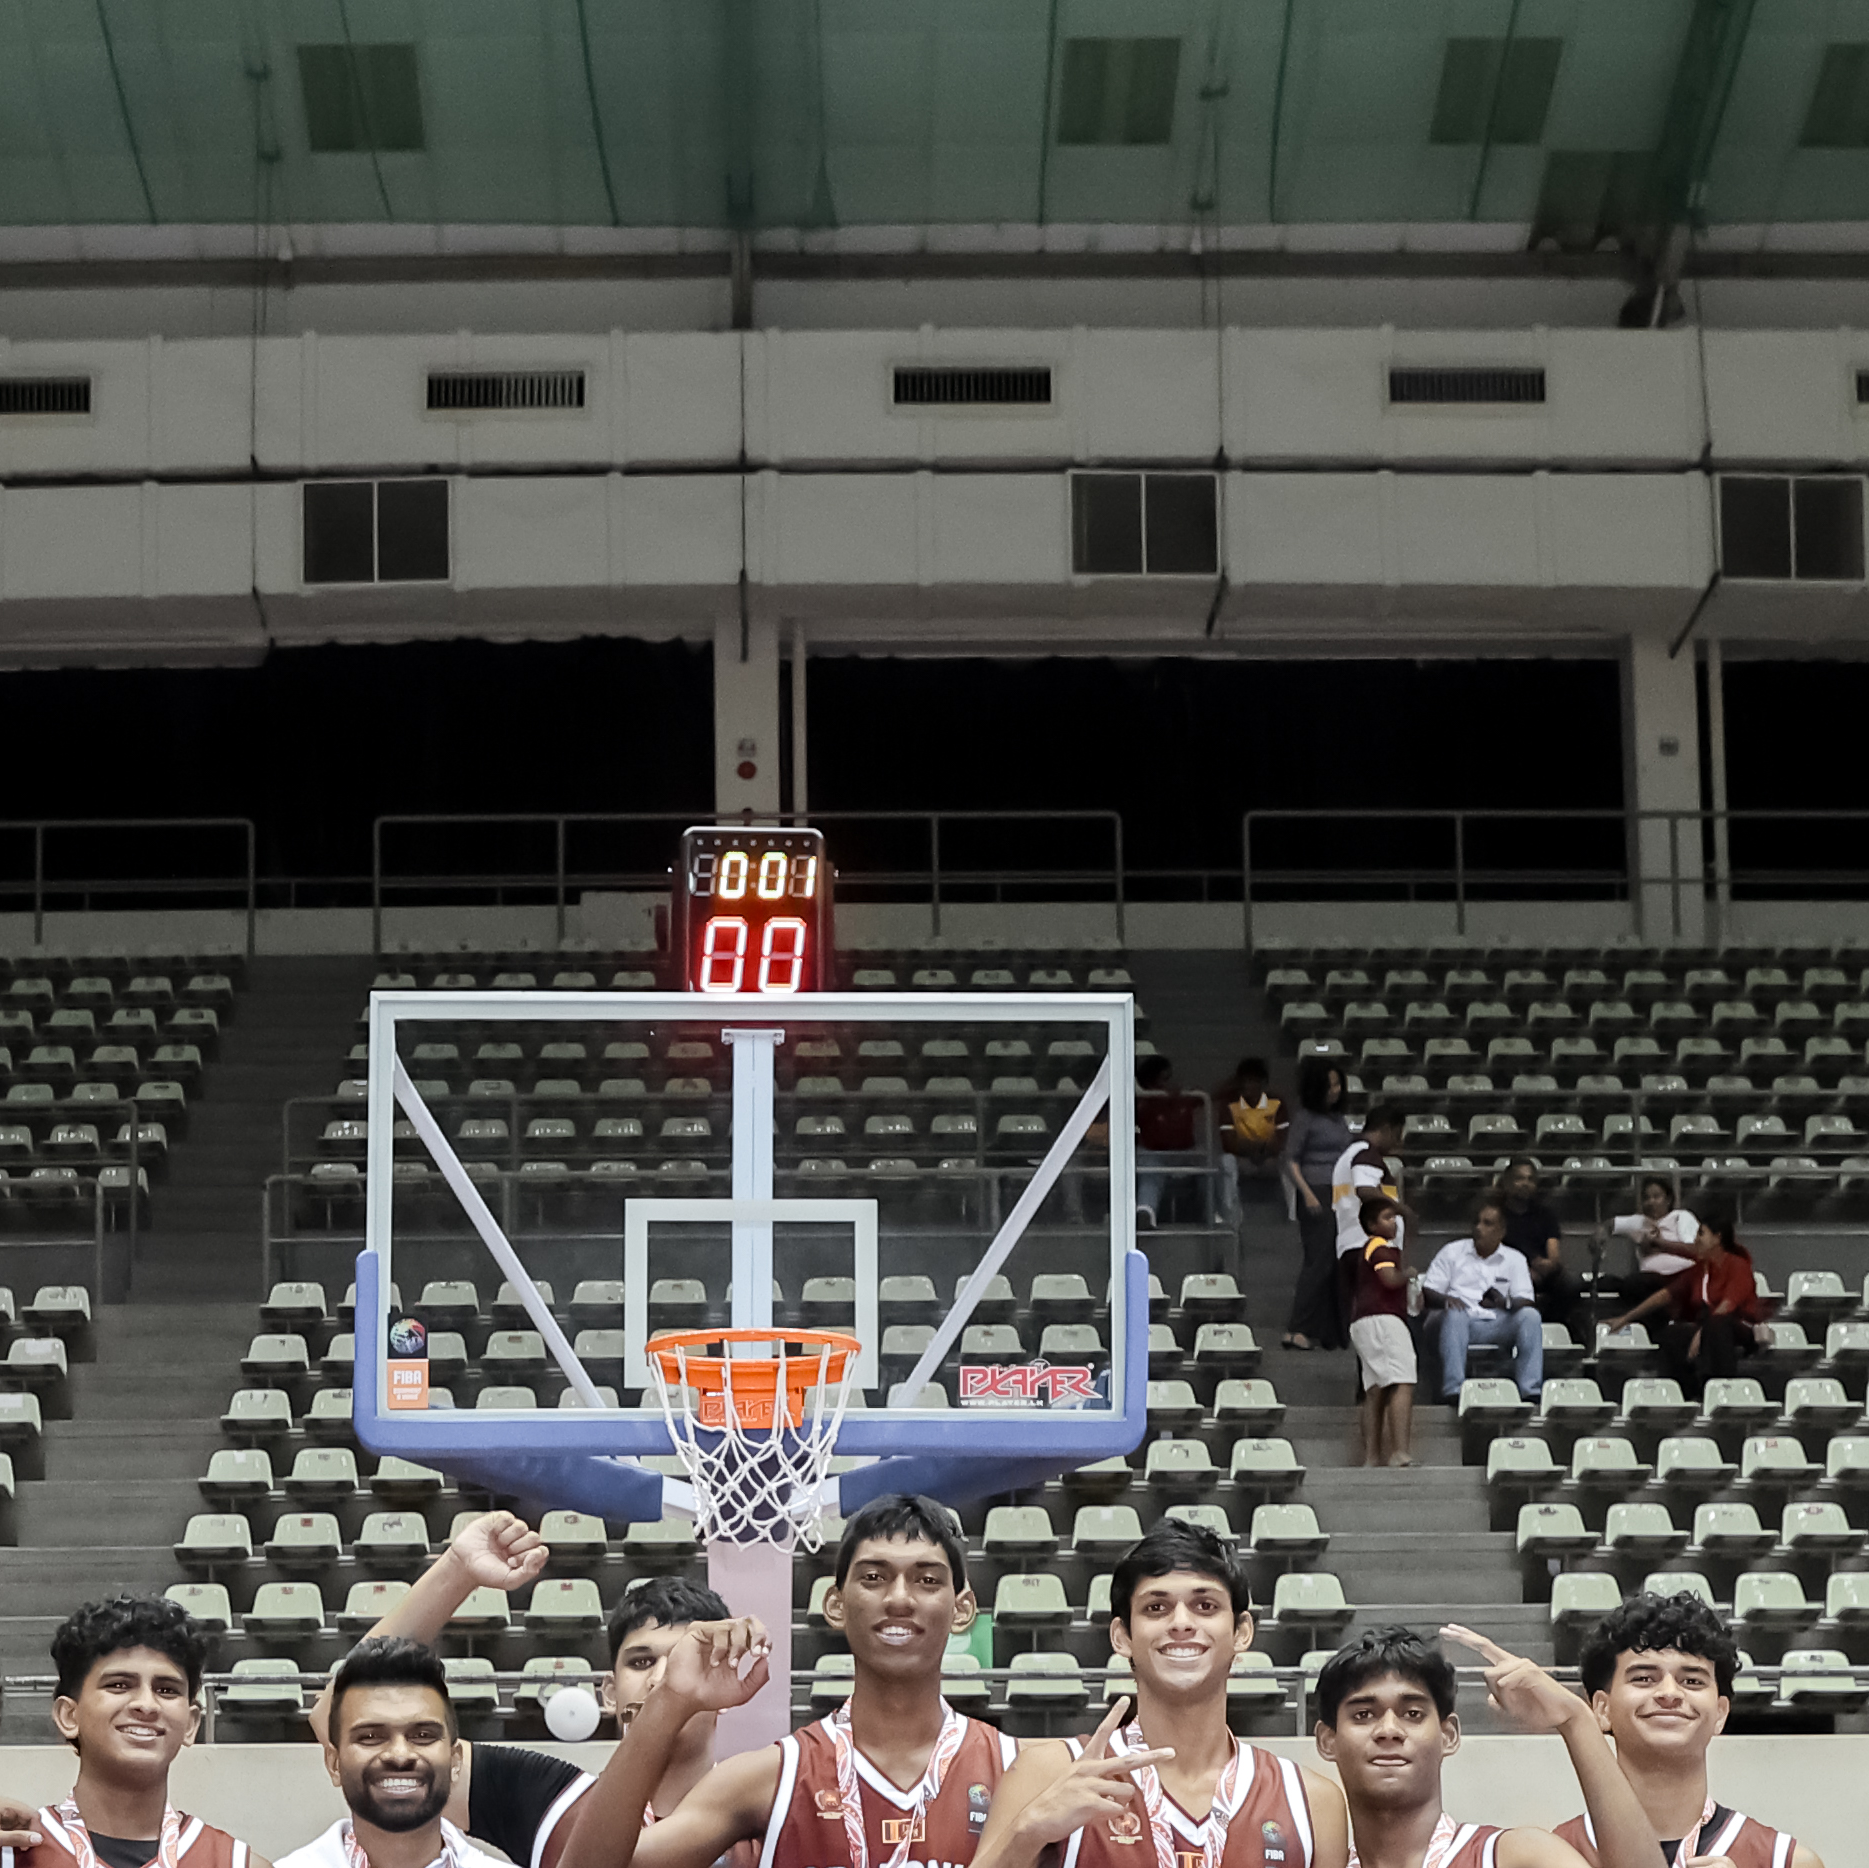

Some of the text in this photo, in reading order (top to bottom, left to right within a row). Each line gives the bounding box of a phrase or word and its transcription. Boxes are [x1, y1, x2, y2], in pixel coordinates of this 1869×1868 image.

[700, 915, 808, 994] 00
[393, 1370, 422, 1385] FIBA
[1265, 1849, 1284, 1861] FIBA
